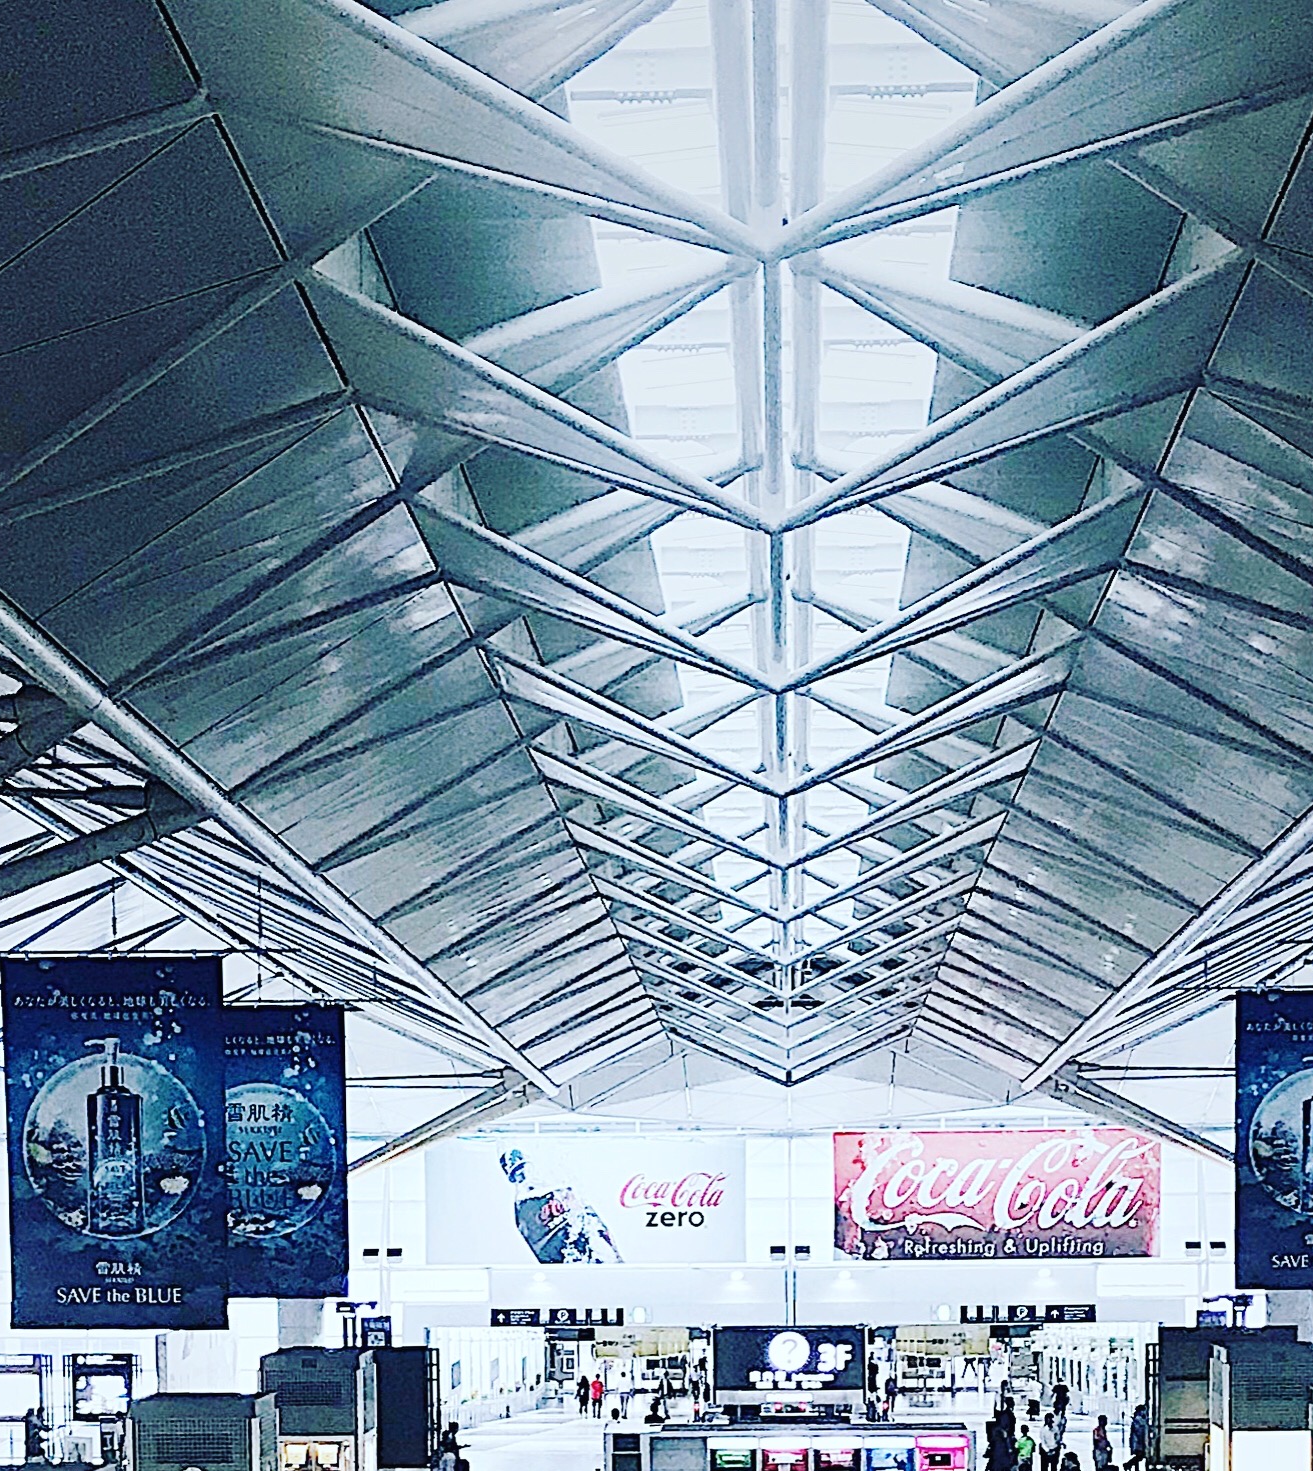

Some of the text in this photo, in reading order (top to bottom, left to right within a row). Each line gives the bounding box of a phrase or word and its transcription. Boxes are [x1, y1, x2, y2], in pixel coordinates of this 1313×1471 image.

[228, 1141, 293, 1163] SAVE
[620, 1172, 730, 1208] Coca-Cola
[840, 1132, 1156, 1232] Coca-Cola
[645, 1211, 705, 1228] zero
[904, 1238, 1106, 1258] Refreshing & Uplifting
[1271, 1255, 1309, 1268] SAVE
[56, 1287, 182, 1304] SAVE the BLUE
[817, 1343, 853, 1372] 3F
